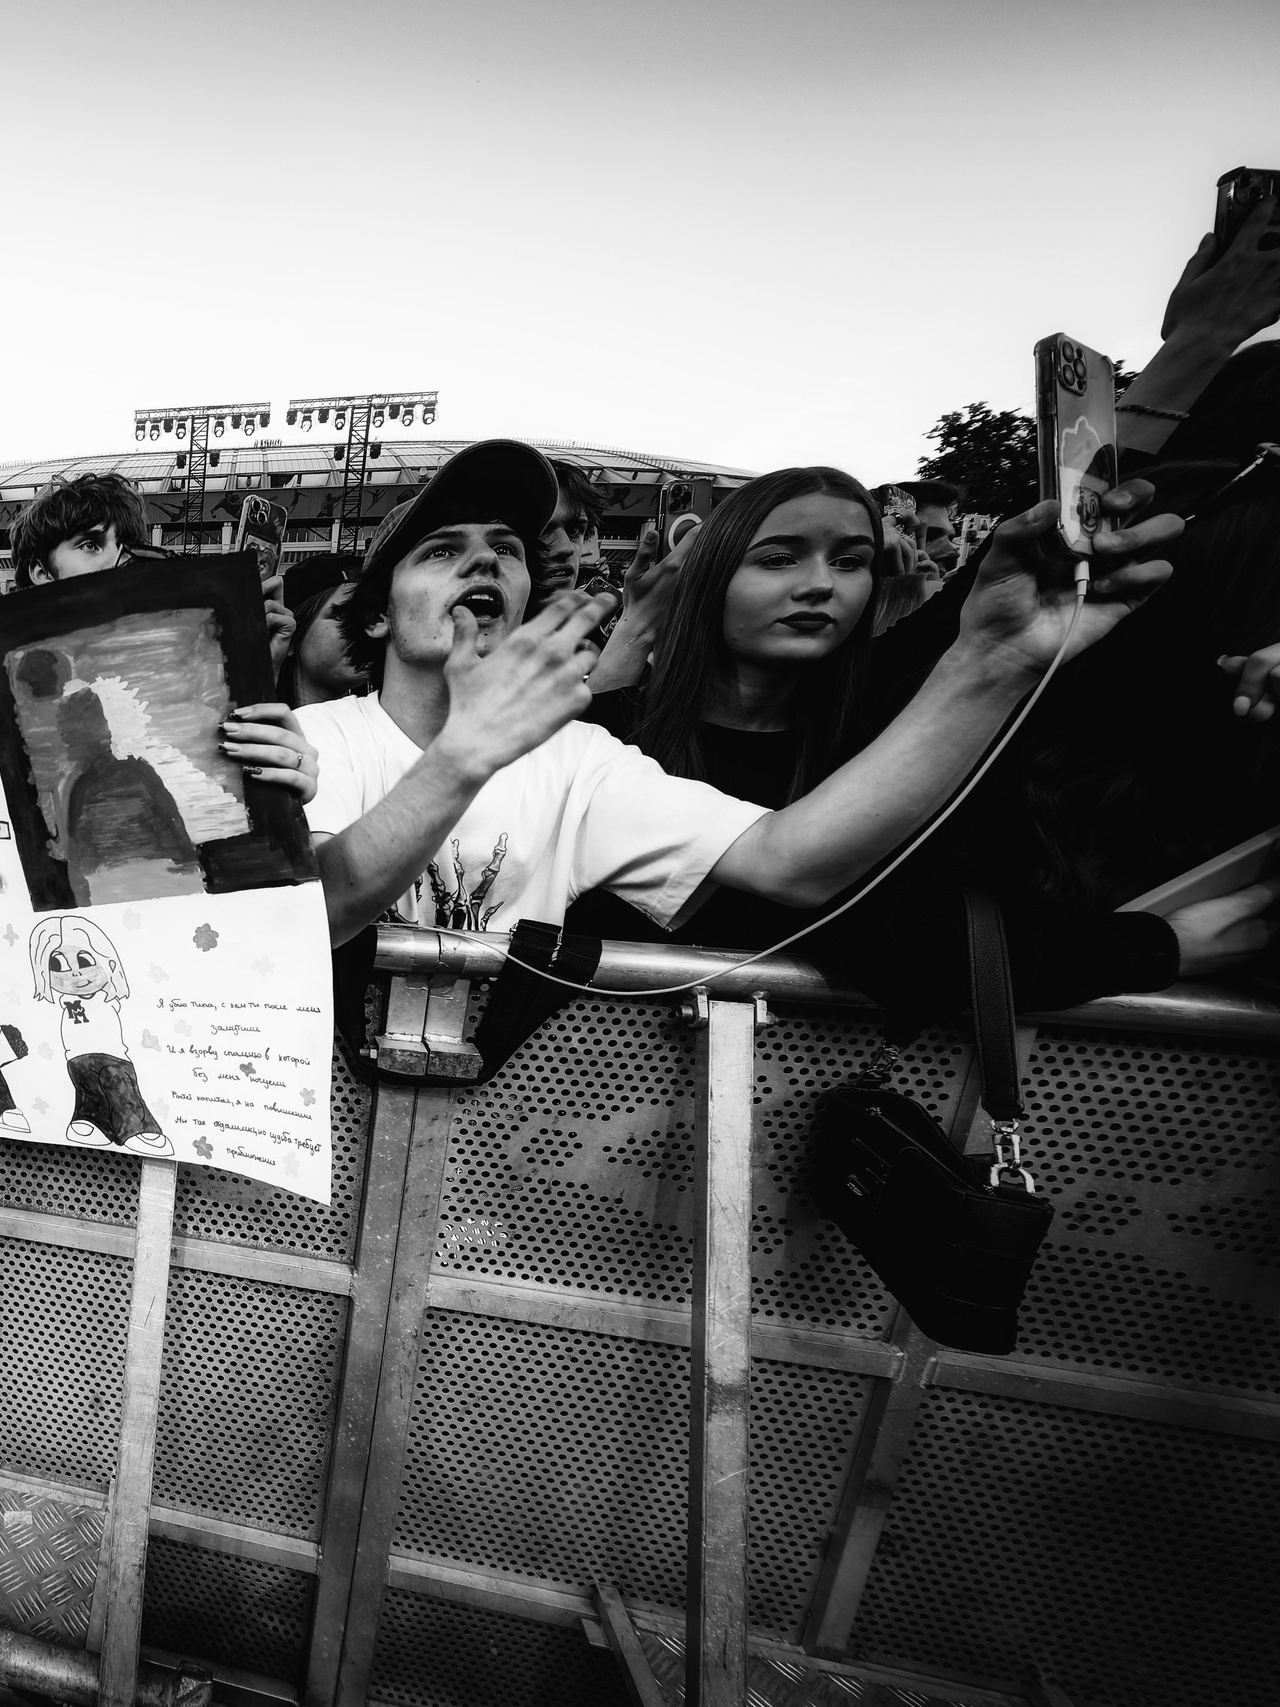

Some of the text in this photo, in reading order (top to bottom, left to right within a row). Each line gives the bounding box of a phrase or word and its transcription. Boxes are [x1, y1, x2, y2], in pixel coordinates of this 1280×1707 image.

[156, 998, 164, 1009] Я
[189, 1044, 219, 1060] взорву
[278, 1053, 311, 1068] которой
[217, 1073, 241, 1082] меня
[244, 1100, 255, 1108] на
